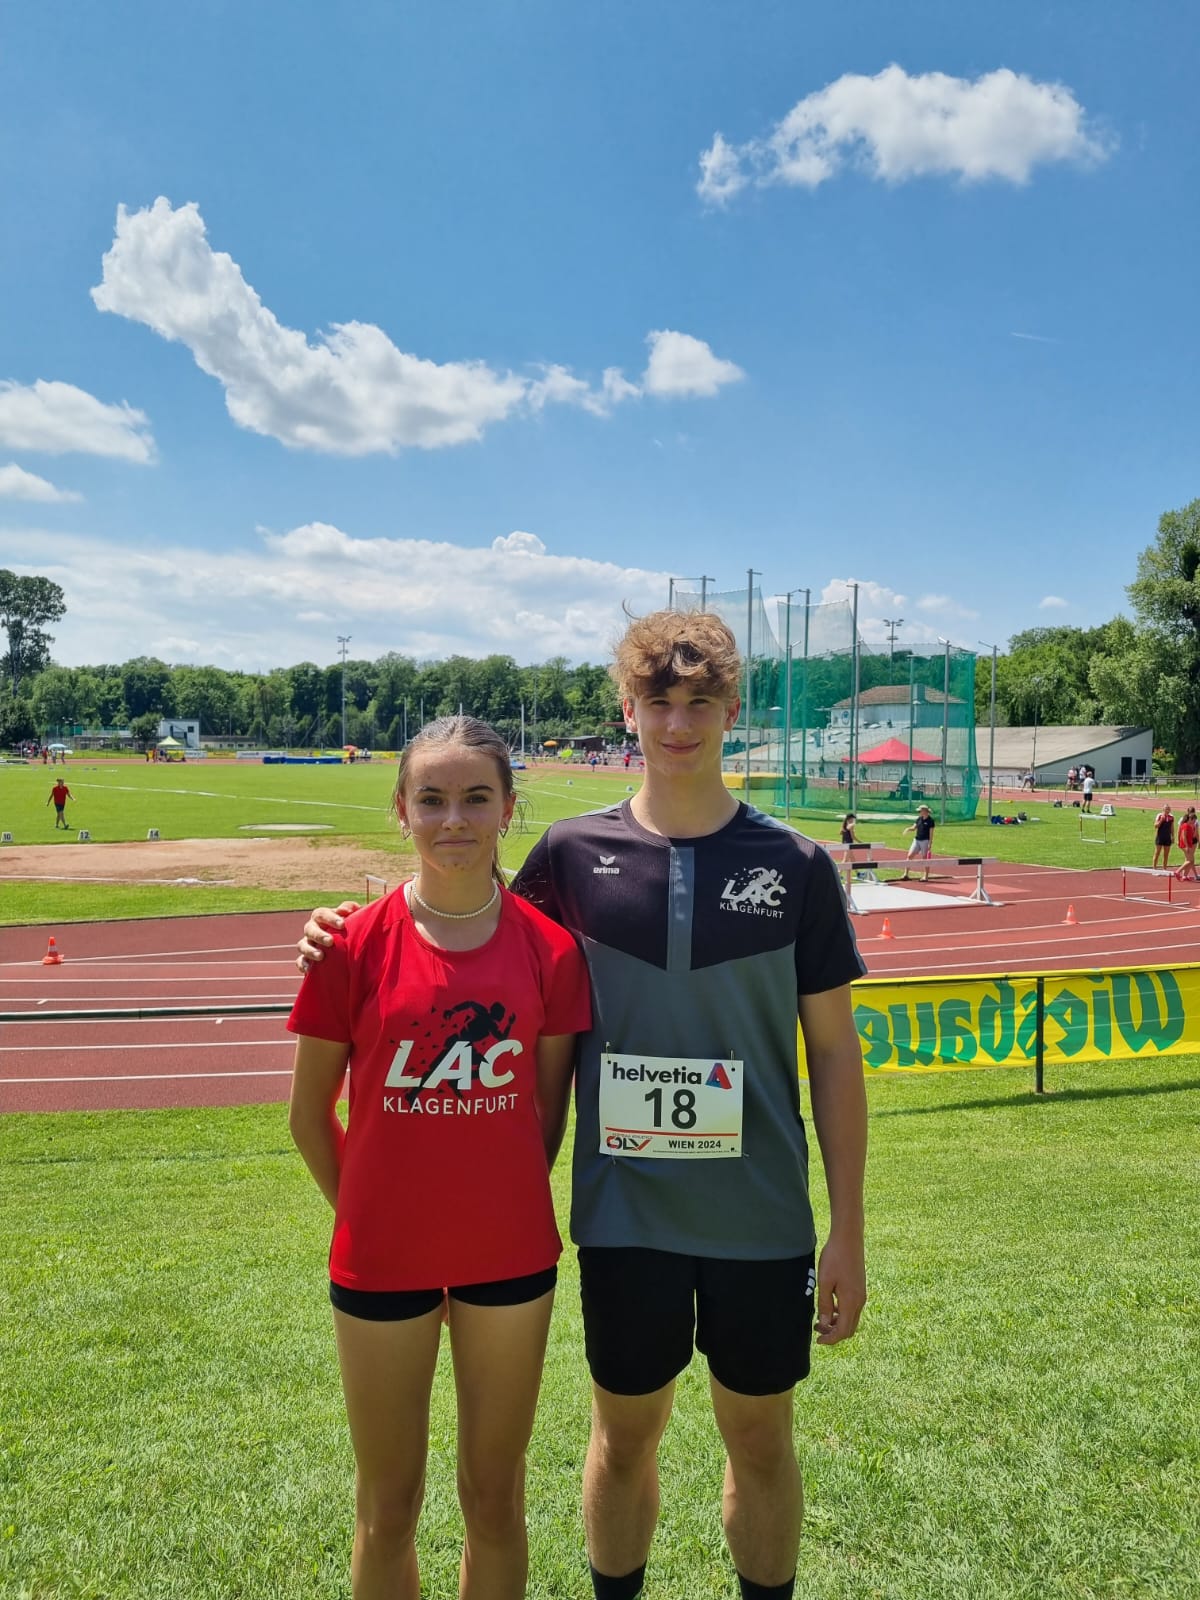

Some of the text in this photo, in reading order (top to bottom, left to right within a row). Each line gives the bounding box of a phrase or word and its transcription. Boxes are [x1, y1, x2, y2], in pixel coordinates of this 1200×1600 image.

[593, 866, 620, 875] erima
[720, 879, 787, 907] LAC
[384, 1039, 524, 1090] LAC
[612, 1062, 702, 1085] helvetia
[383, 1093, 519, 1115] KLAGENFURT
[644, 1088, 697, 1130] 18
[668, 1140, 721, 1149] WIEN 2024
